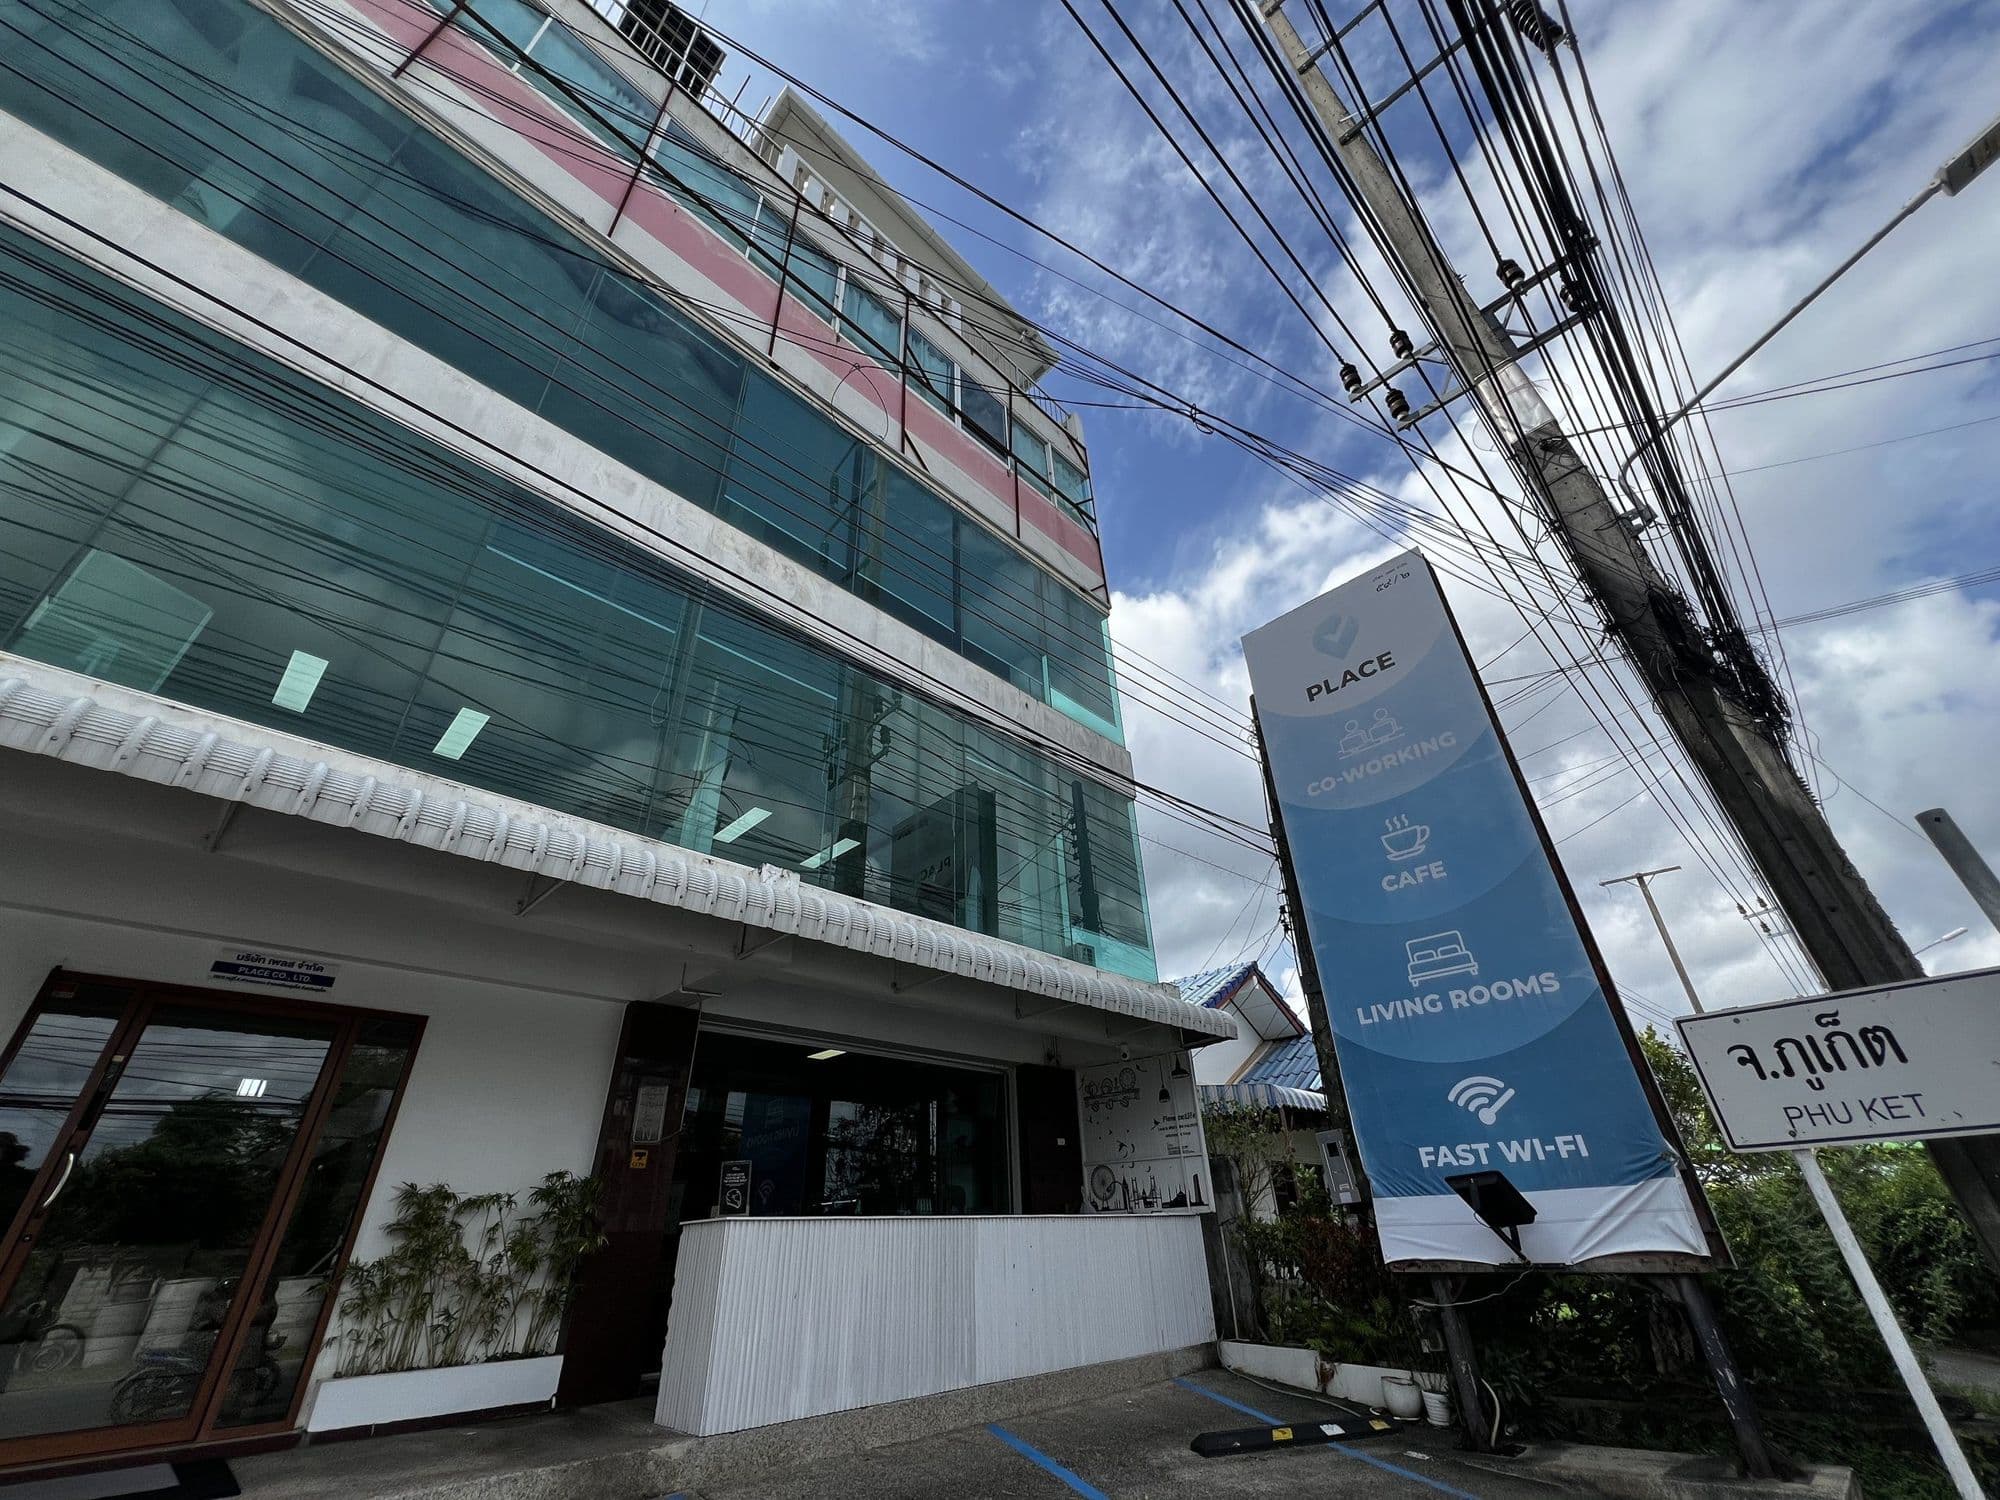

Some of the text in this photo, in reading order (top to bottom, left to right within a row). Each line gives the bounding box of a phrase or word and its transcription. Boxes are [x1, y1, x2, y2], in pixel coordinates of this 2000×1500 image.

[1305, 651, 1397, 702] PLACE
[1307, 731, 1457, 797] CO-WORKING
[1381, 860, 1448, 892] CAFE
[238, 966, 272, 978] PLACE
[1356, 972, 1561, 1026] LIVING ROOMS
[1727, 1009, 1909, 1091] จ.ภูเก็ต
[1418, 1134, 1590, 1168] FAST WI-FI
